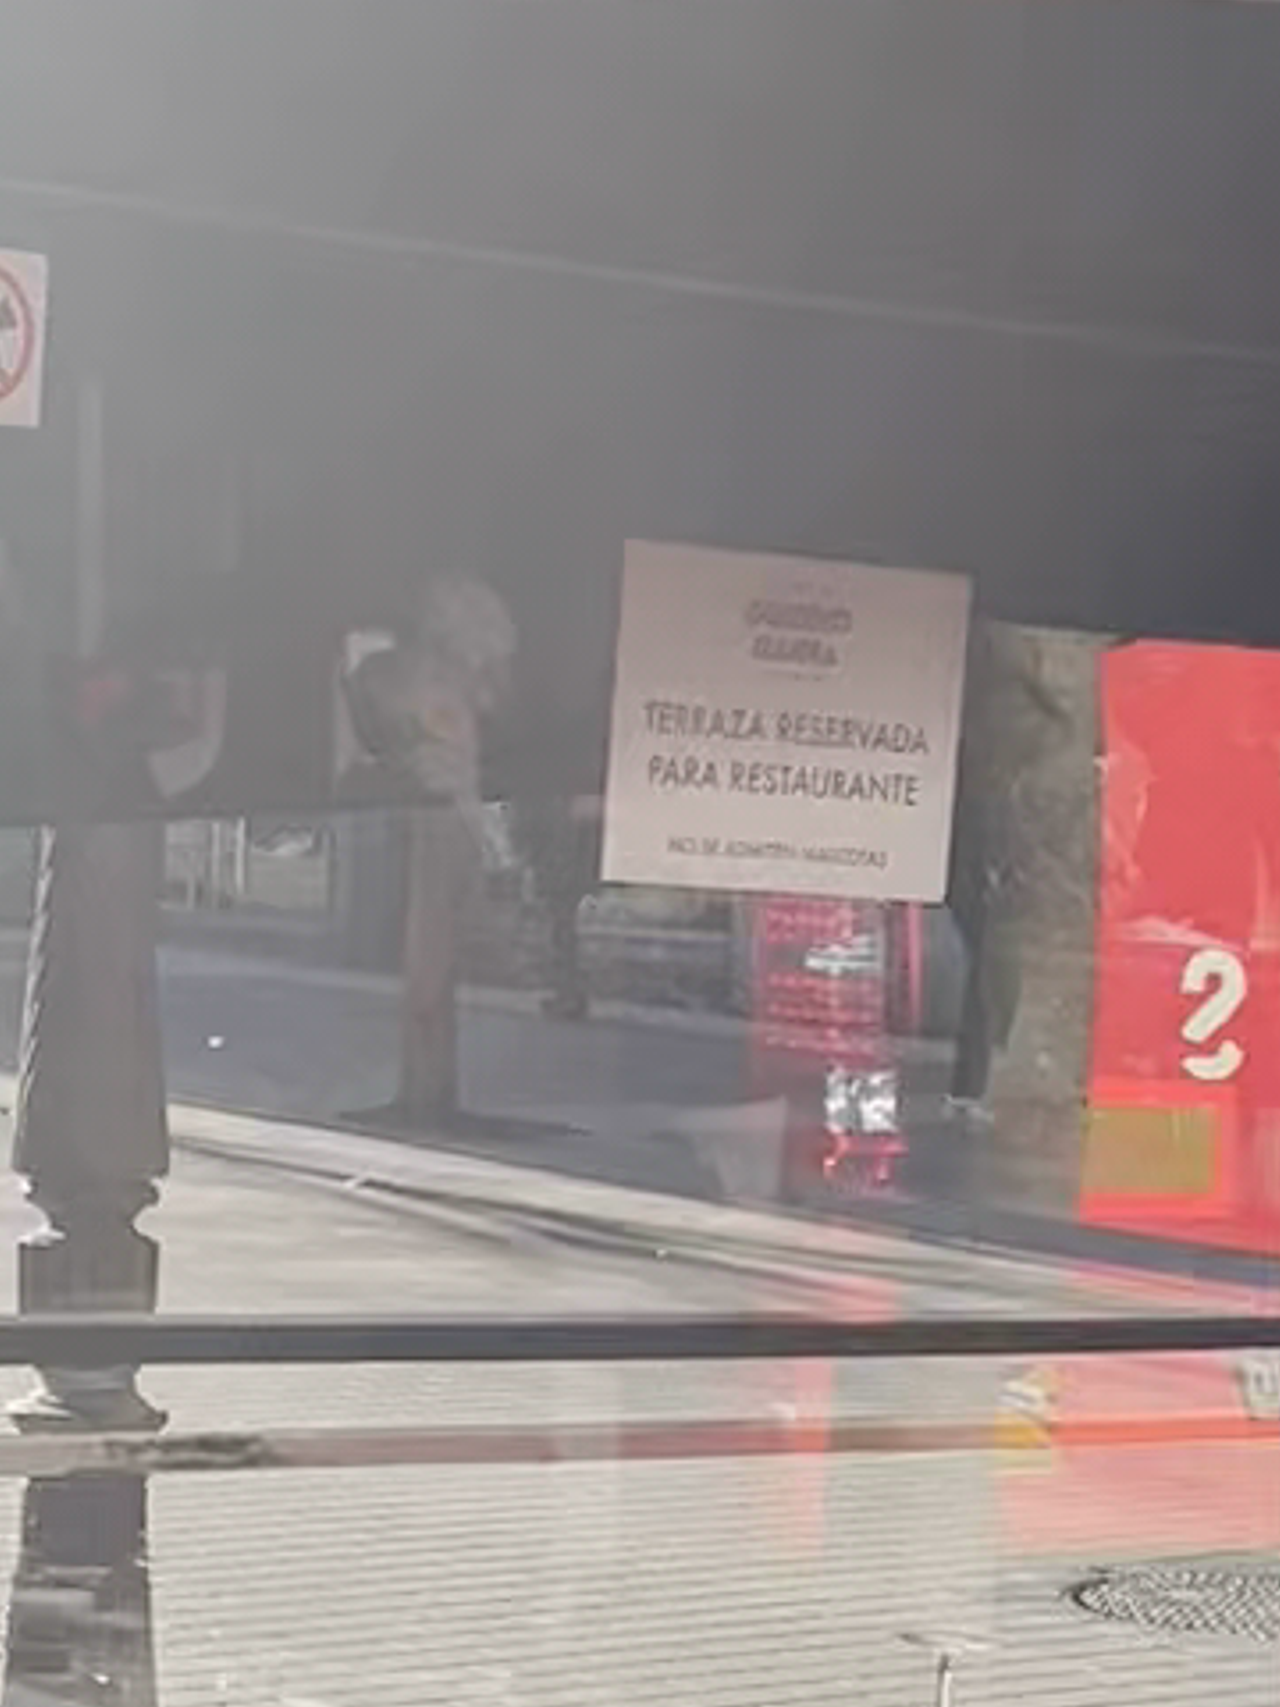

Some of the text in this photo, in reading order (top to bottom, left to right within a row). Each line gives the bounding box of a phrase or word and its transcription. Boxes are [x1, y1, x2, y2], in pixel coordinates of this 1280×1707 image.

[642, 700, 930, 757] TERRAZA RESERVADA
[647, 754, 921, 807] PARA RESTAURANTE
